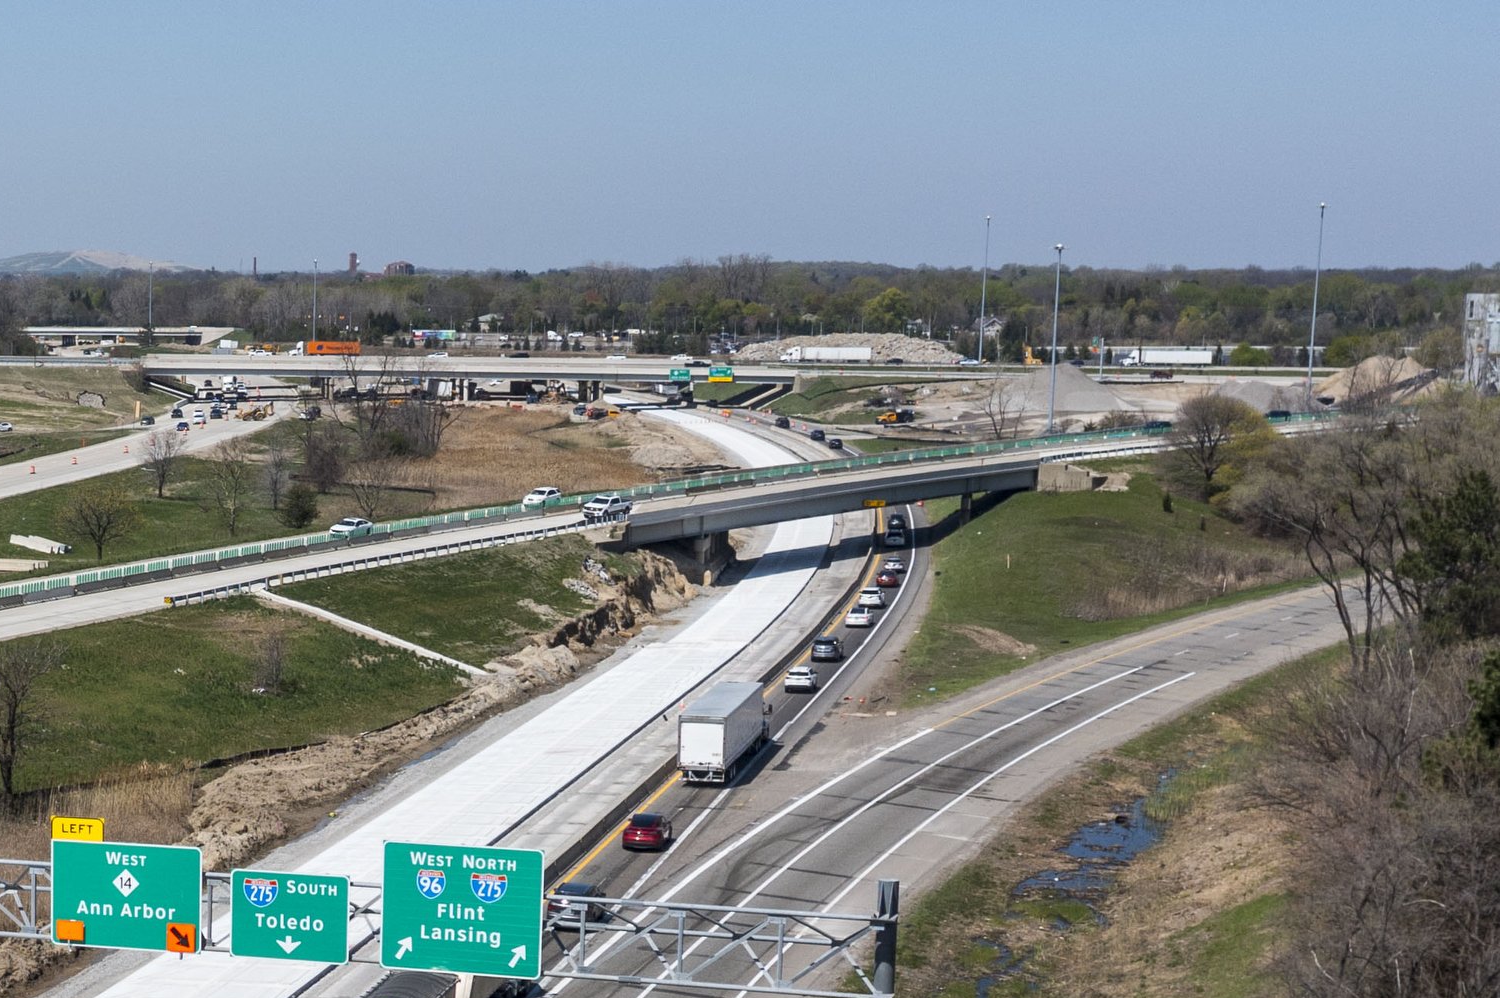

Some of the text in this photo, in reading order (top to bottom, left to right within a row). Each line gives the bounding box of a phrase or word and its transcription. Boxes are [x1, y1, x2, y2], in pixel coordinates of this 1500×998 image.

[61, 823, 94, 835] LEFT
[105, 851, 147, 867] WEST
[410, 851, 517, 872] WEST NORTH
[119, 876, 133, 890] 14
[250, 880, 338, 902] 275 SOUTH
[419, 876, 502, 898] 96 275
[77, 900, 176, 920] Ann Arbor
[437, 903, 485, 921] Flint
[255, 913, 325, 932] Toledo
[420, 925, 501, 948] Lansing
